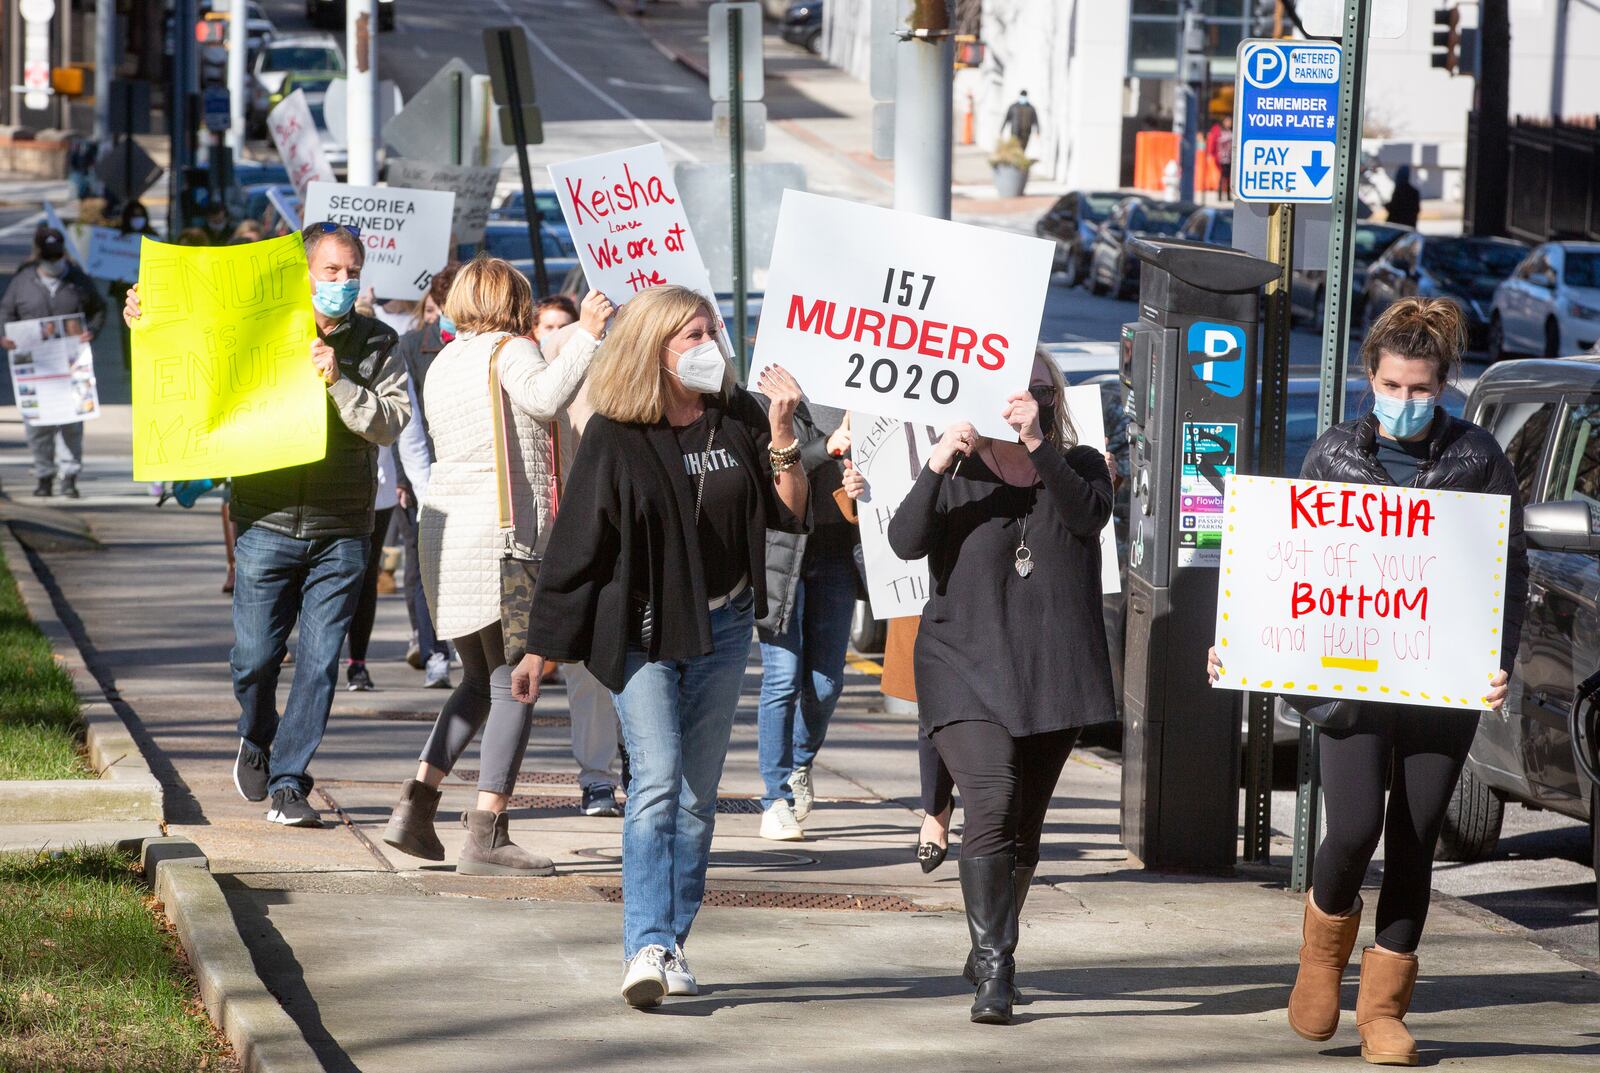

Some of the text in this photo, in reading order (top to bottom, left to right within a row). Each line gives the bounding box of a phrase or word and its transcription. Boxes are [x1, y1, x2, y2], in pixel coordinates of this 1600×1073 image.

[1294, 53, 1335, 65] METERED
[1295, 68, 1333, 79] PARKING
[1248, 114, 1335, 128] YOUR PLATE #
[1257, 97, 1327, 111] REMEMBER
[1254, 147, 1289, 166] PAY
[566, 163, 675, 225] Keisha
[1245, 171, 1296, 190] HERE
[329, 195, 416, 214] SECORIEA
[588, 223, 686, 270] We are at
[144, 238, 301, 314] ENUF
[626, 268, 667, 292] the
[882, 268, 936, 311] 157
[786, 294, 1009, 371] MURDERS
[153, 330, 304, 405] ENUF
[845, 353, 960, 405] 2020
[1290, 485, 1435, 537] KEISHA
[1265, 539, 1313, 582] get
[1372, 552, 1437, 589] your
[1261, 624, 1305, 652] and
